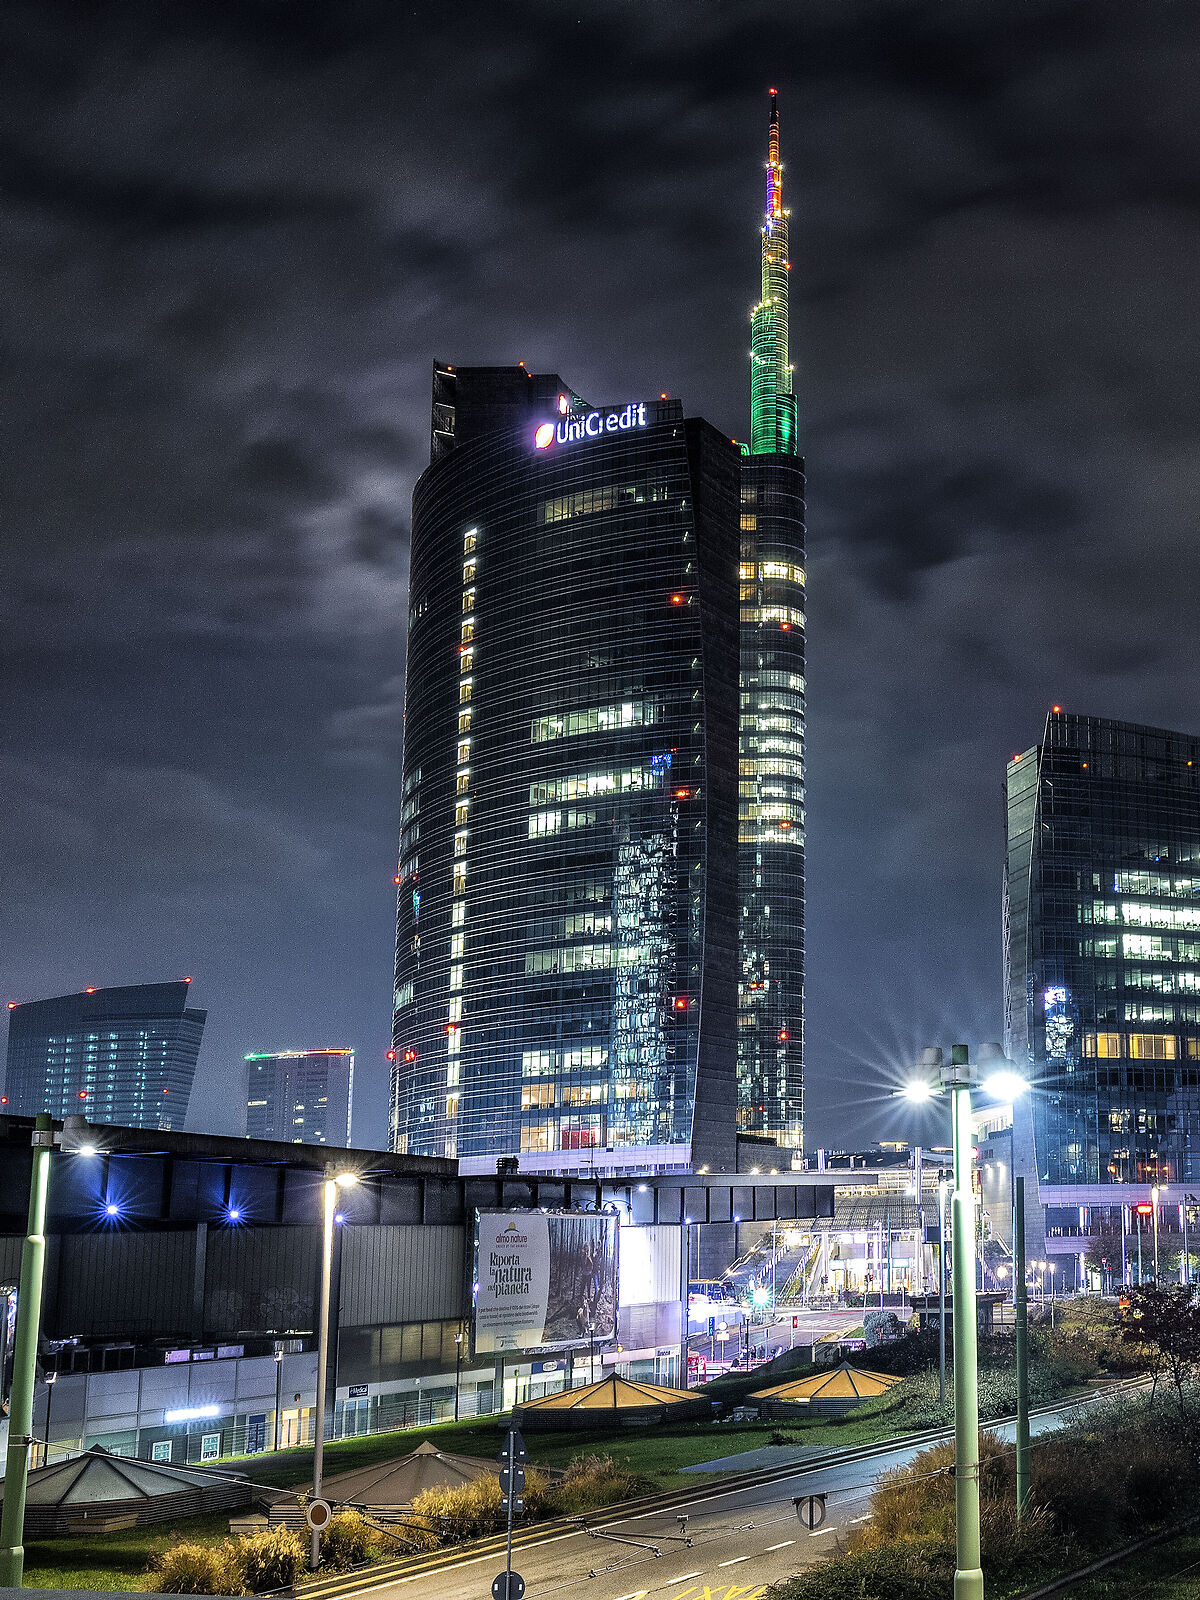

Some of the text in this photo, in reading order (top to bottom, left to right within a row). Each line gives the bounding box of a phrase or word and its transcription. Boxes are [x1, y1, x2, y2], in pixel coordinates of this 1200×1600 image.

[556, 402, 646, 444] UniCredit
[495, 1233, 527, 1243] almo nature
[489, 1252, 520, 1268] Riporta
[490, 1266, 533, 1283] la natura
[495, 1282, 529, 1299] pianeta
